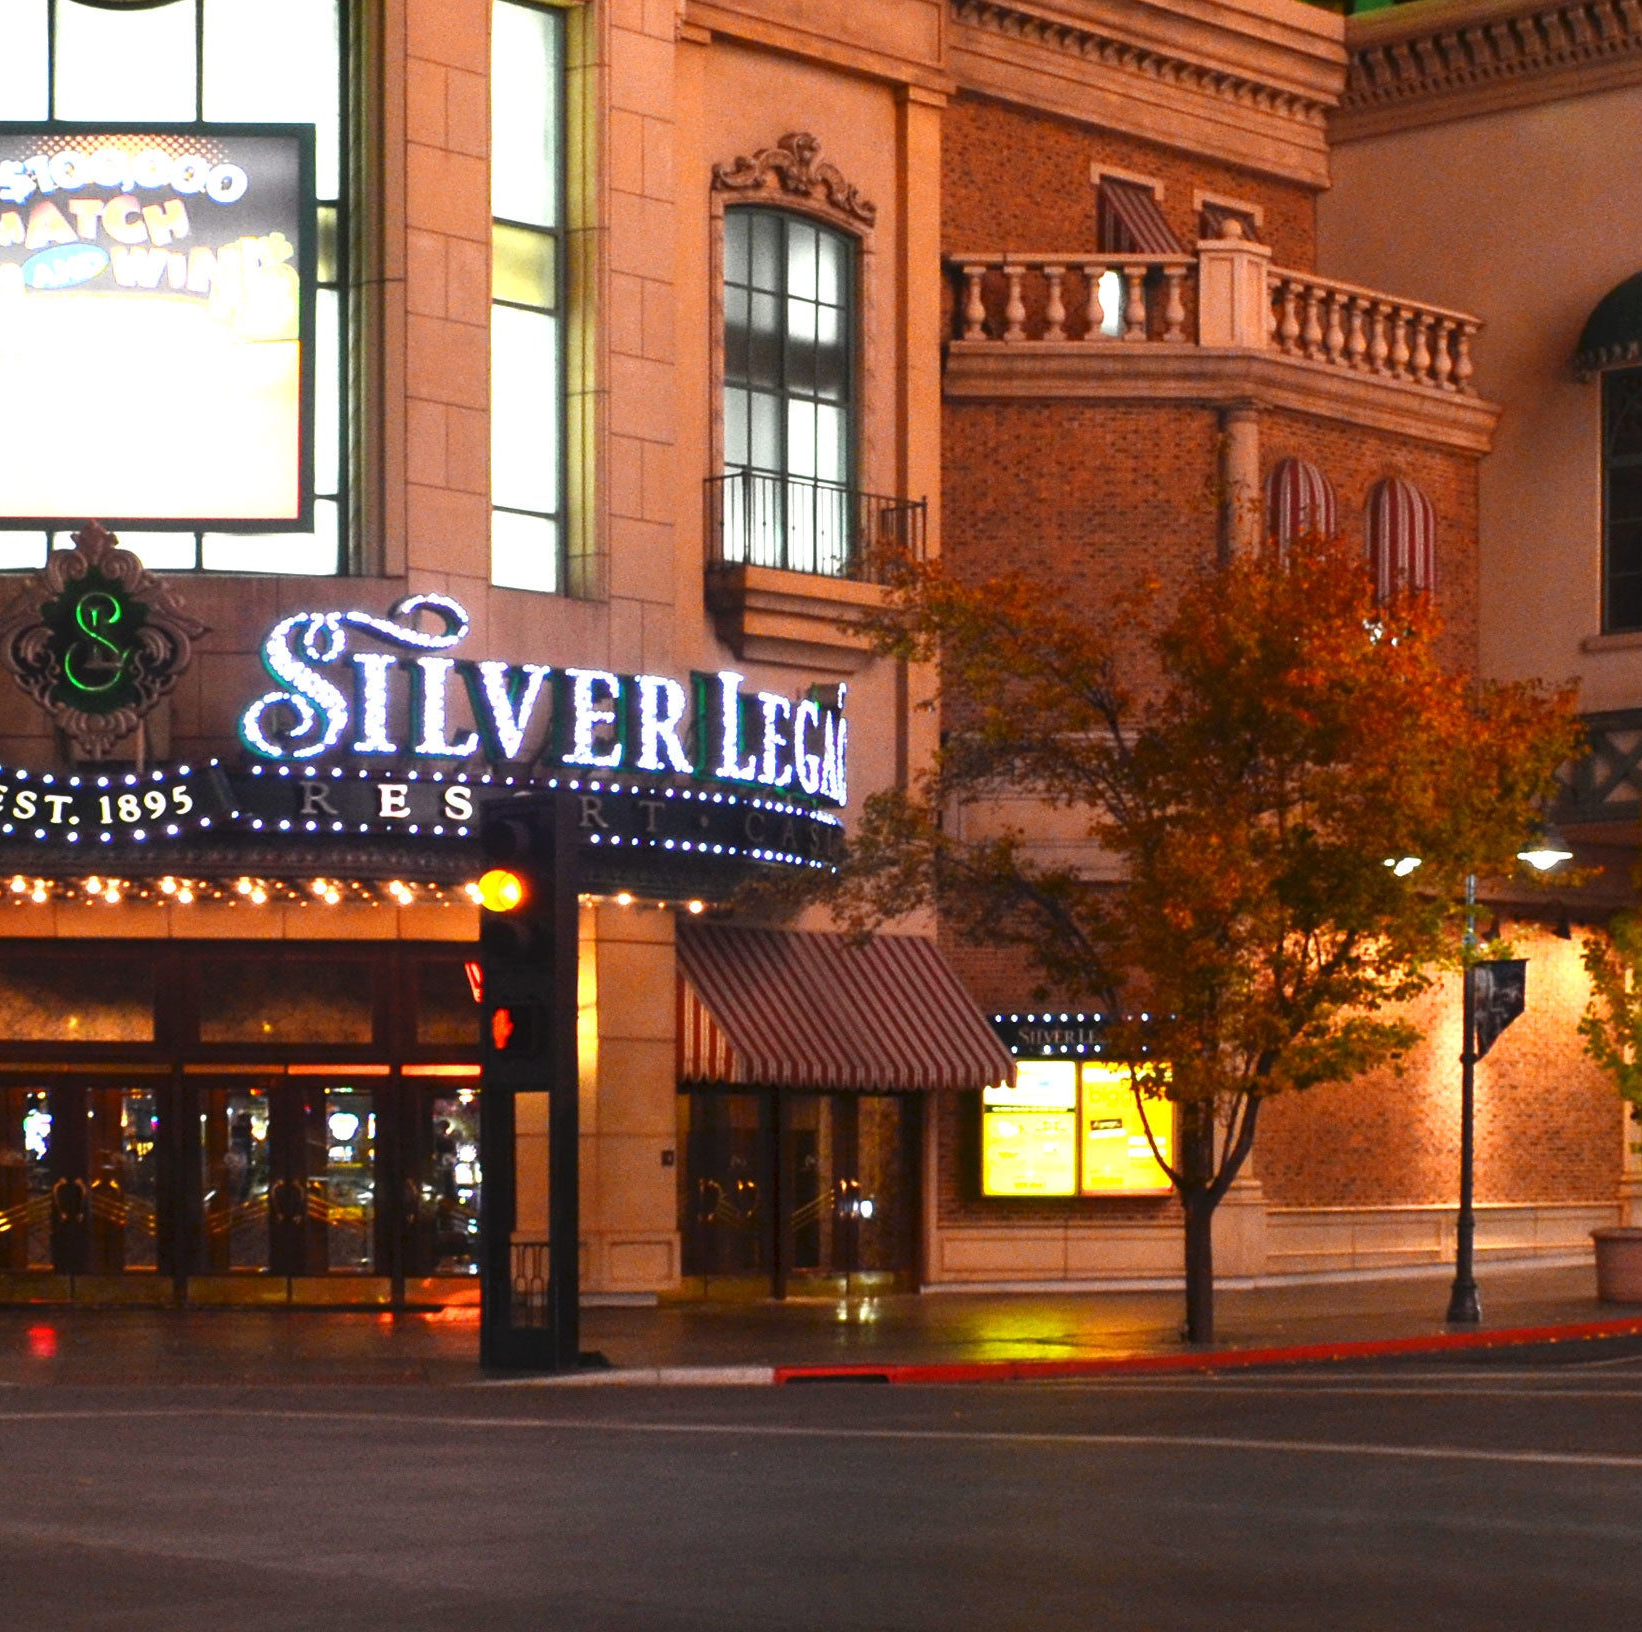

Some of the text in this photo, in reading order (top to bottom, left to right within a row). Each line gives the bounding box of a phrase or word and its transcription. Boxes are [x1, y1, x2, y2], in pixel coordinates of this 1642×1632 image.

[238, 592, 693, 774] SILVER
[99, 783, 195, 825] 1895
[299, 782, 666, 832] RESRT
